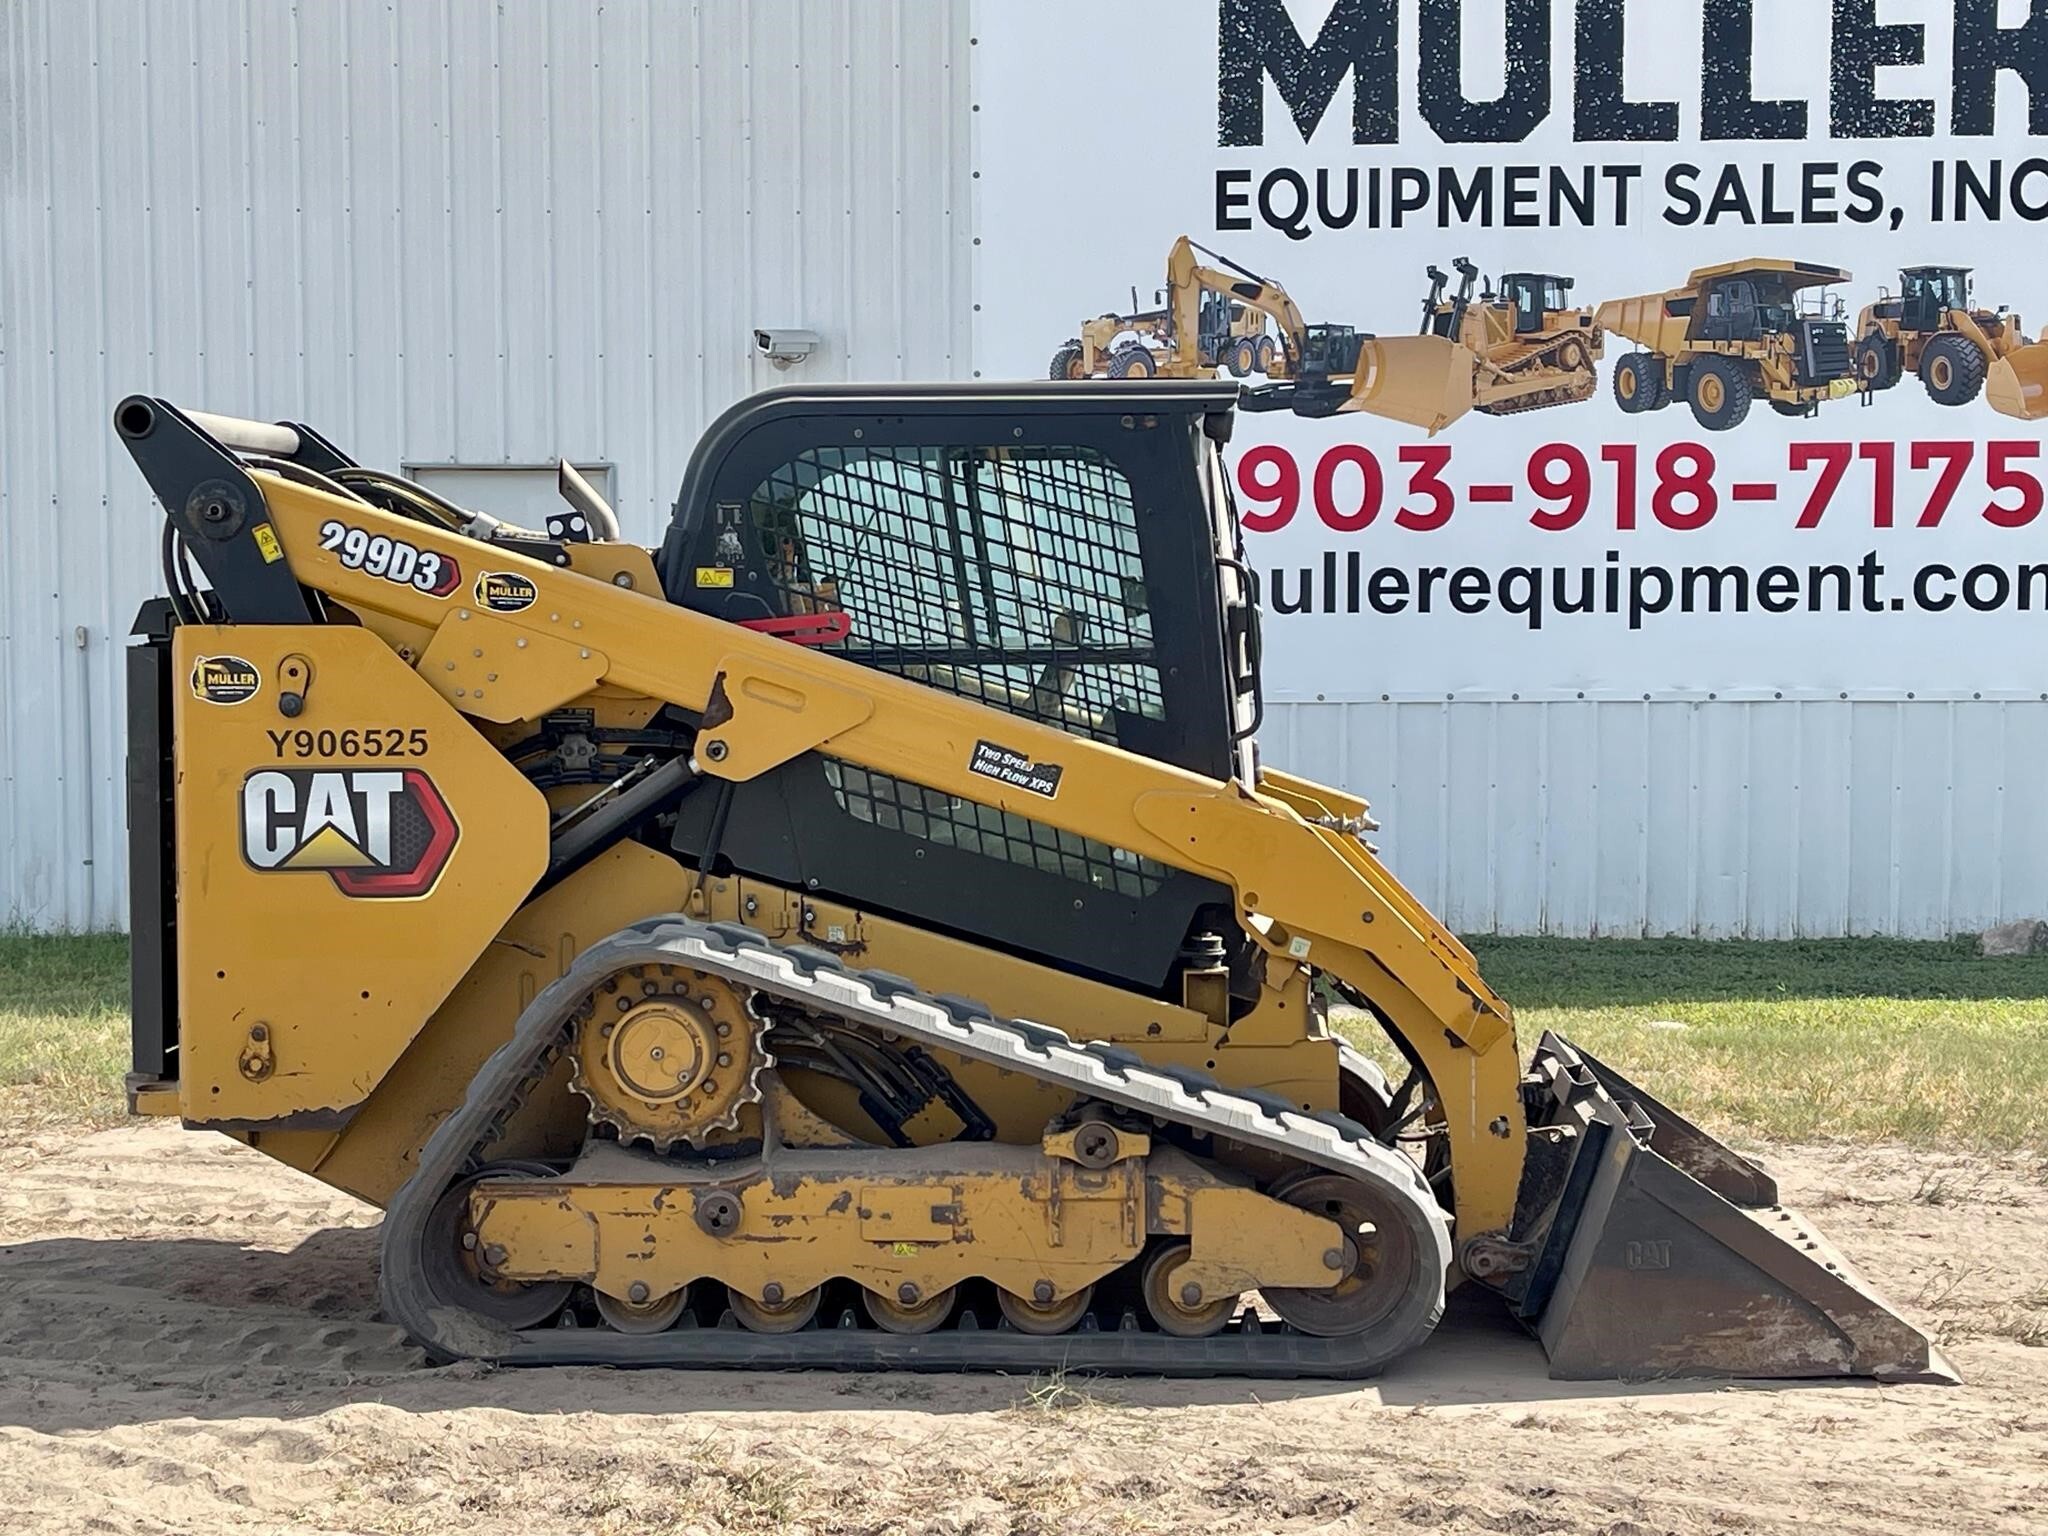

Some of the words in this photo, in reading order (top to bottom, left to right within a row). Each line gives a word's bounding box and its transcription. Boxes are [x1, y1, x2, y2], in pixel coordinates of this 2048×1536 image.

[1217, 0, 2048, 147] MULLER
[1215, 166, 1642, 241] EQUIPMENT
[1662, 161, 1904, 231] SALES,
[1931, 158, 2048, 222] INC
[1238, 441, 2043, 532] 903-918-7175
[321, 521, 441, 590] 299D3
[489, 586, 533, 597] MULLER
[207, 673, 255, 685] MULLER
[267, 729, 428, 757] Y906525
[1029, 777, 1054, 793] XPS
[244, 771, 404, 868] CAT
[1625, 1240, 1672, 1271] CAT
